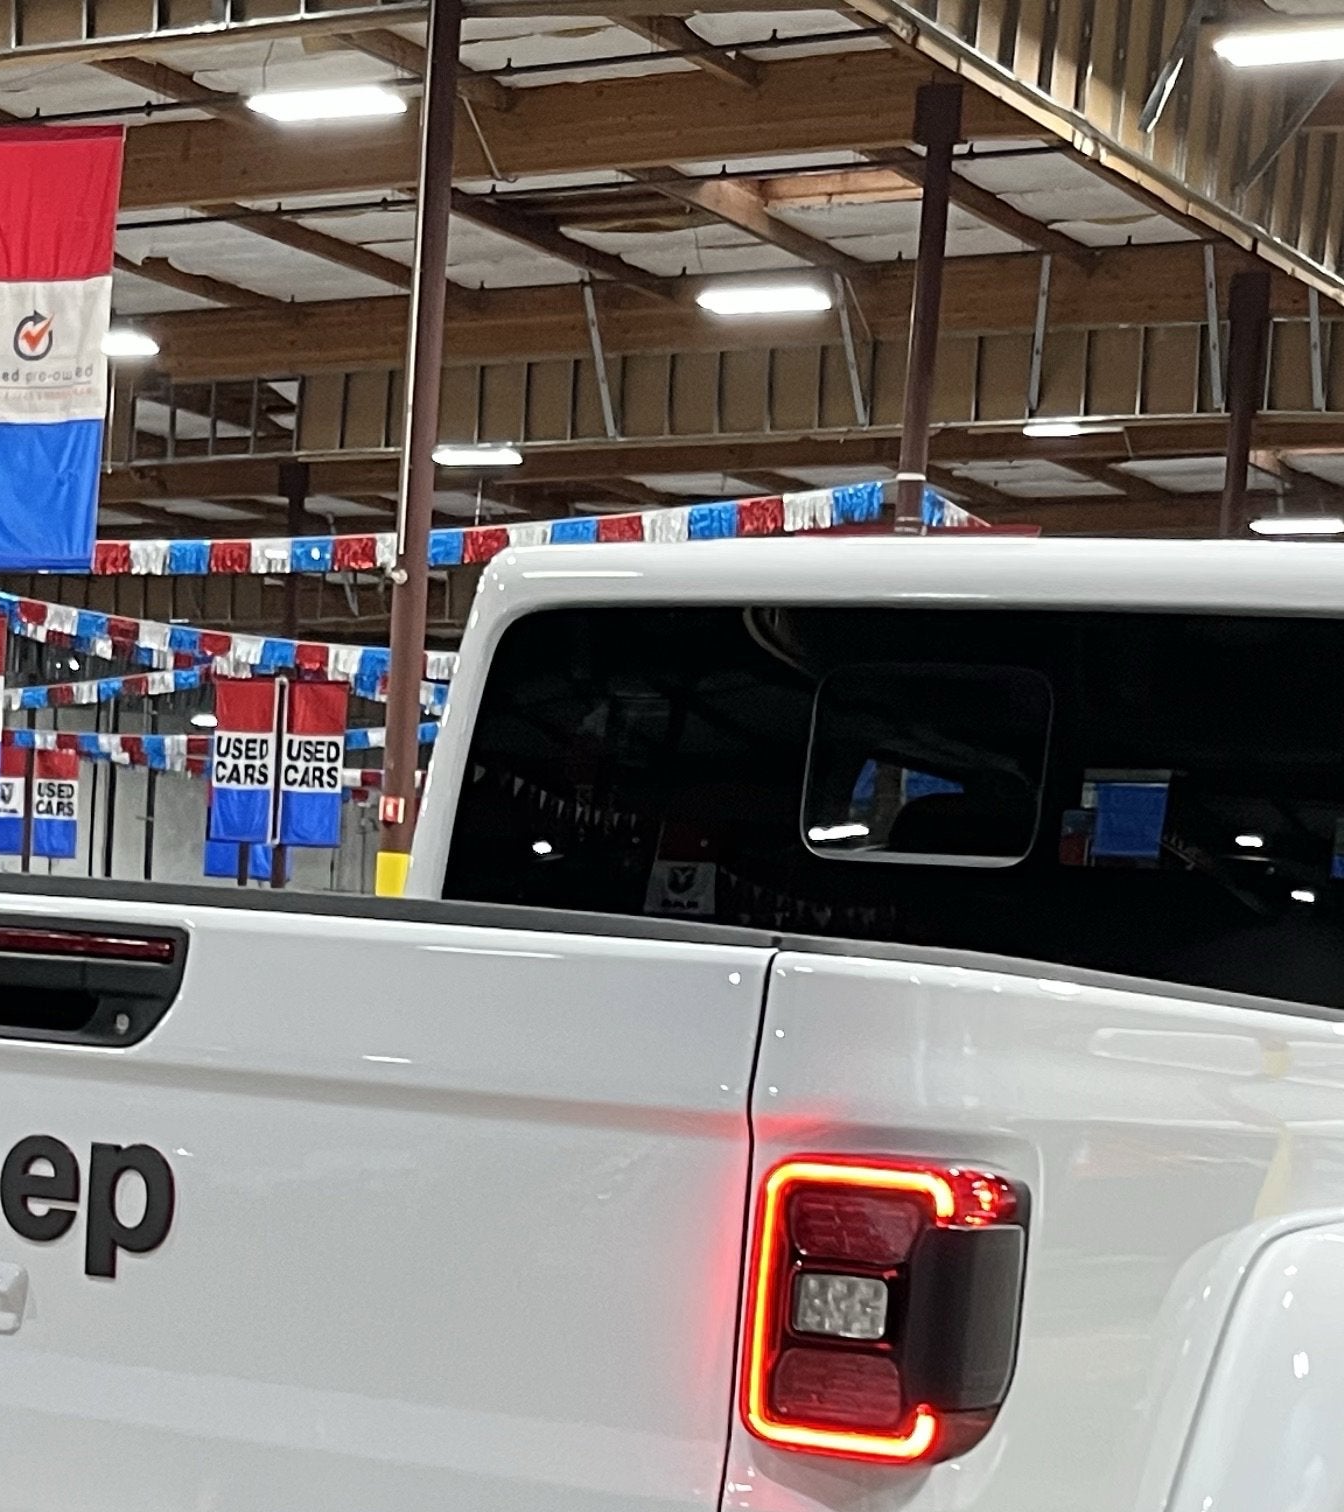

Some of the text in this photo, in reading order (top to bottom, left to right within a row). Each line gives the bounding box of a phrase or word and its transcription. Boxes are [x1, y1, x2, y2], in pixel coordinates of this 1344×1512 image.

[216, 736, 269, 760] USED
[286, 739, 340, 763] USED
[215, 761, 268, 785] CARS
[284, 764, 338, 788] CARS
[37, 782, 75, 799] USED
[36, 799, 74, 817] CARS
